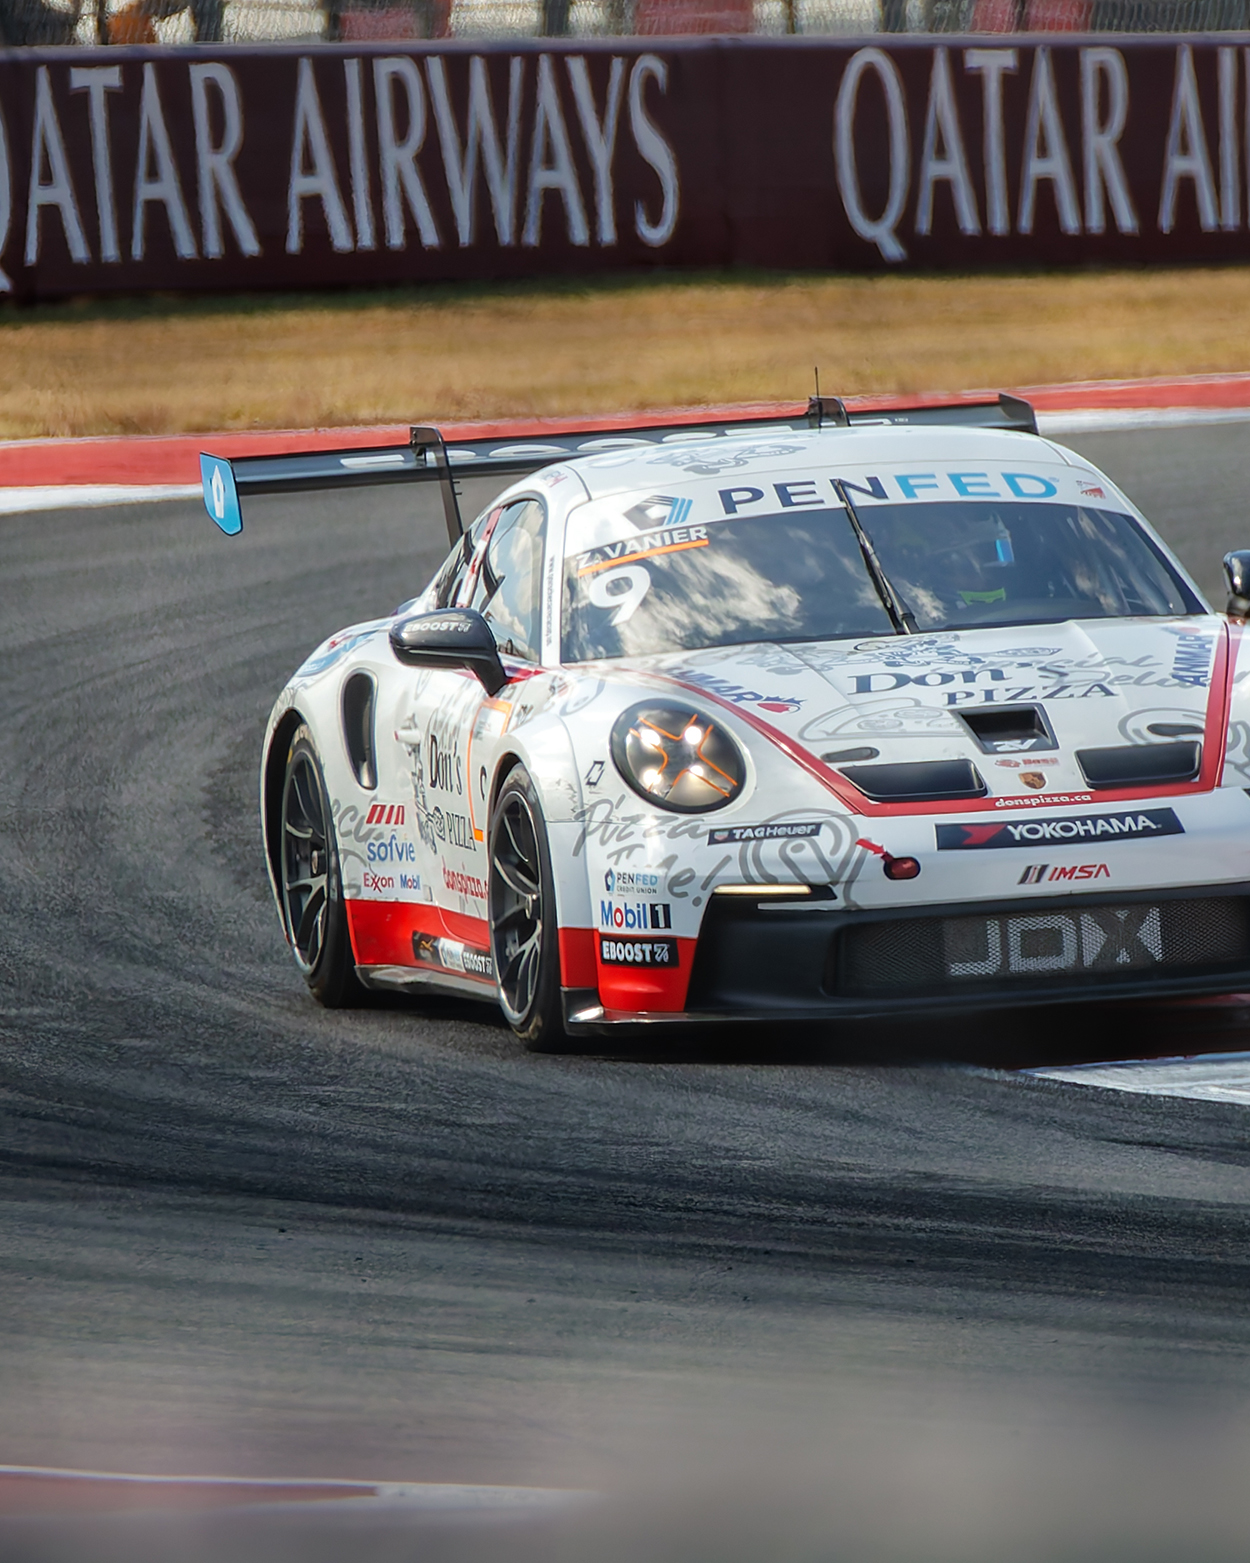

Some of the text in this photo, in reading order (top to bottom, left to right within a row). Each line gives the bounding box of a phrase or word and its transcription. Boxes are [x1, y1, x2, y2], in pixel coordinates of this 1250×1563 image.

[834, 44, 1139, 262] QATAR
[0, 53, 679, 294] ATAR AIRWAYS
[718, 472, 1056, 515] PENFED
[603, 526, 709, 559] VANIER
[588, 565, 651, 627] 9
[942, 683, 1120, 706] PIZZA
[429, 734, 463, 796] Don's
[994, 793, 1092, 808] donspizza.ca
[445, 811, 477, 852] PIZZA
[1007, 814, 1157, 841] YOKOHAMA
[367, 833, 416, 862] sofvie
[363, 872, 395, 894] Exxon
[616, 872, 658, 887] PENFED
[1048, 863, 1111, 882] IMSA
[616, 885, 657, 895] CREDIT UNION
[600, 900, 669, 930] Mobil 1
[602, 940, 652, 963] EBOOST
